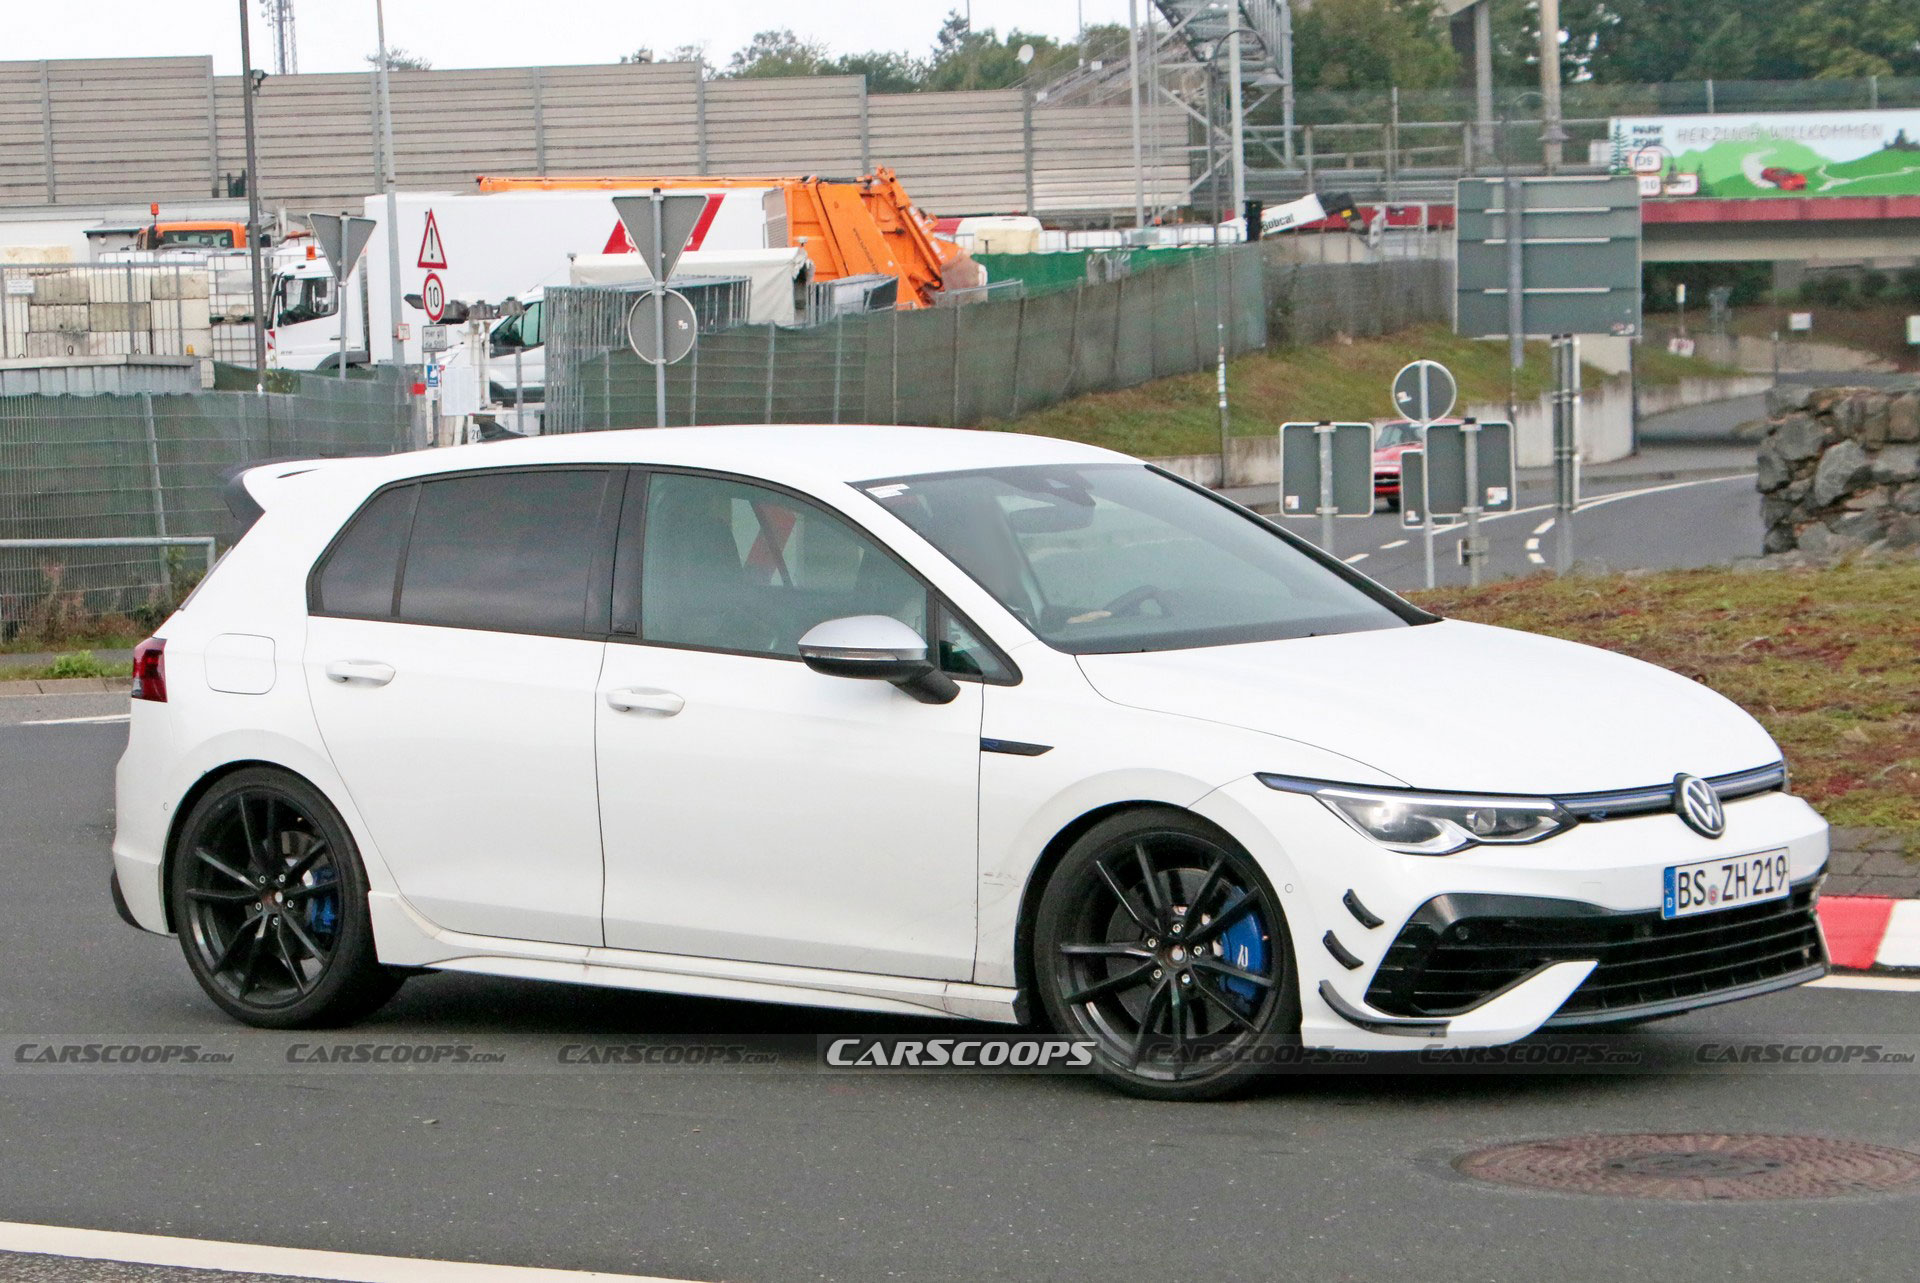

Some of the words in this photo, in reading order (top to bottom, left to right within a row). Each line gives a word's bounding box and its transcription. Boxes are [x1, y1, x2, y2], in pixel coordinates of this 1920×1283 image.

[1677, 125, 1760, 144] HERZLICH
[1769, 122, 1884, 141] WILLKOMMEN
[428, 286, 439, 308] 10
[1678, 870, 1706, 909] BS
[1721, 862, 1747, 901] ZH
[1752, 855, 1787, 896] 219
